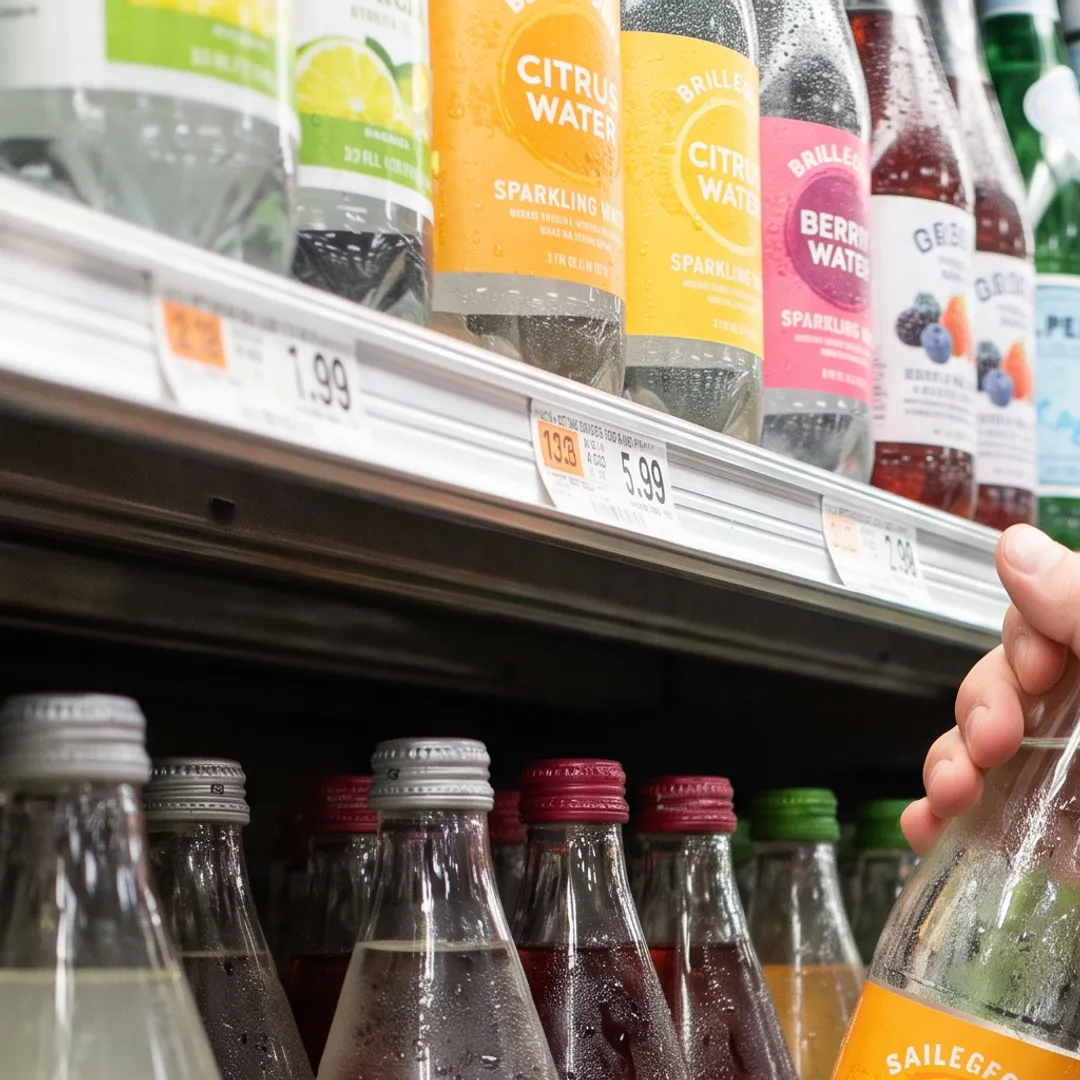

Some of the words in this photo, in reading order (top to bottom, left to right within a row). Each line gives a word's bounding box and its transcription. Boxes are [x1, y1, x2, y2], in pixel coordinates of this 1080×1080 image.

[516, 53, 618, 113] CITRUS
[525, 91, 617, 147] WATER
[493, 179, 598, 216] SPARKLING
[620, 451, 666, 505] 5.99
